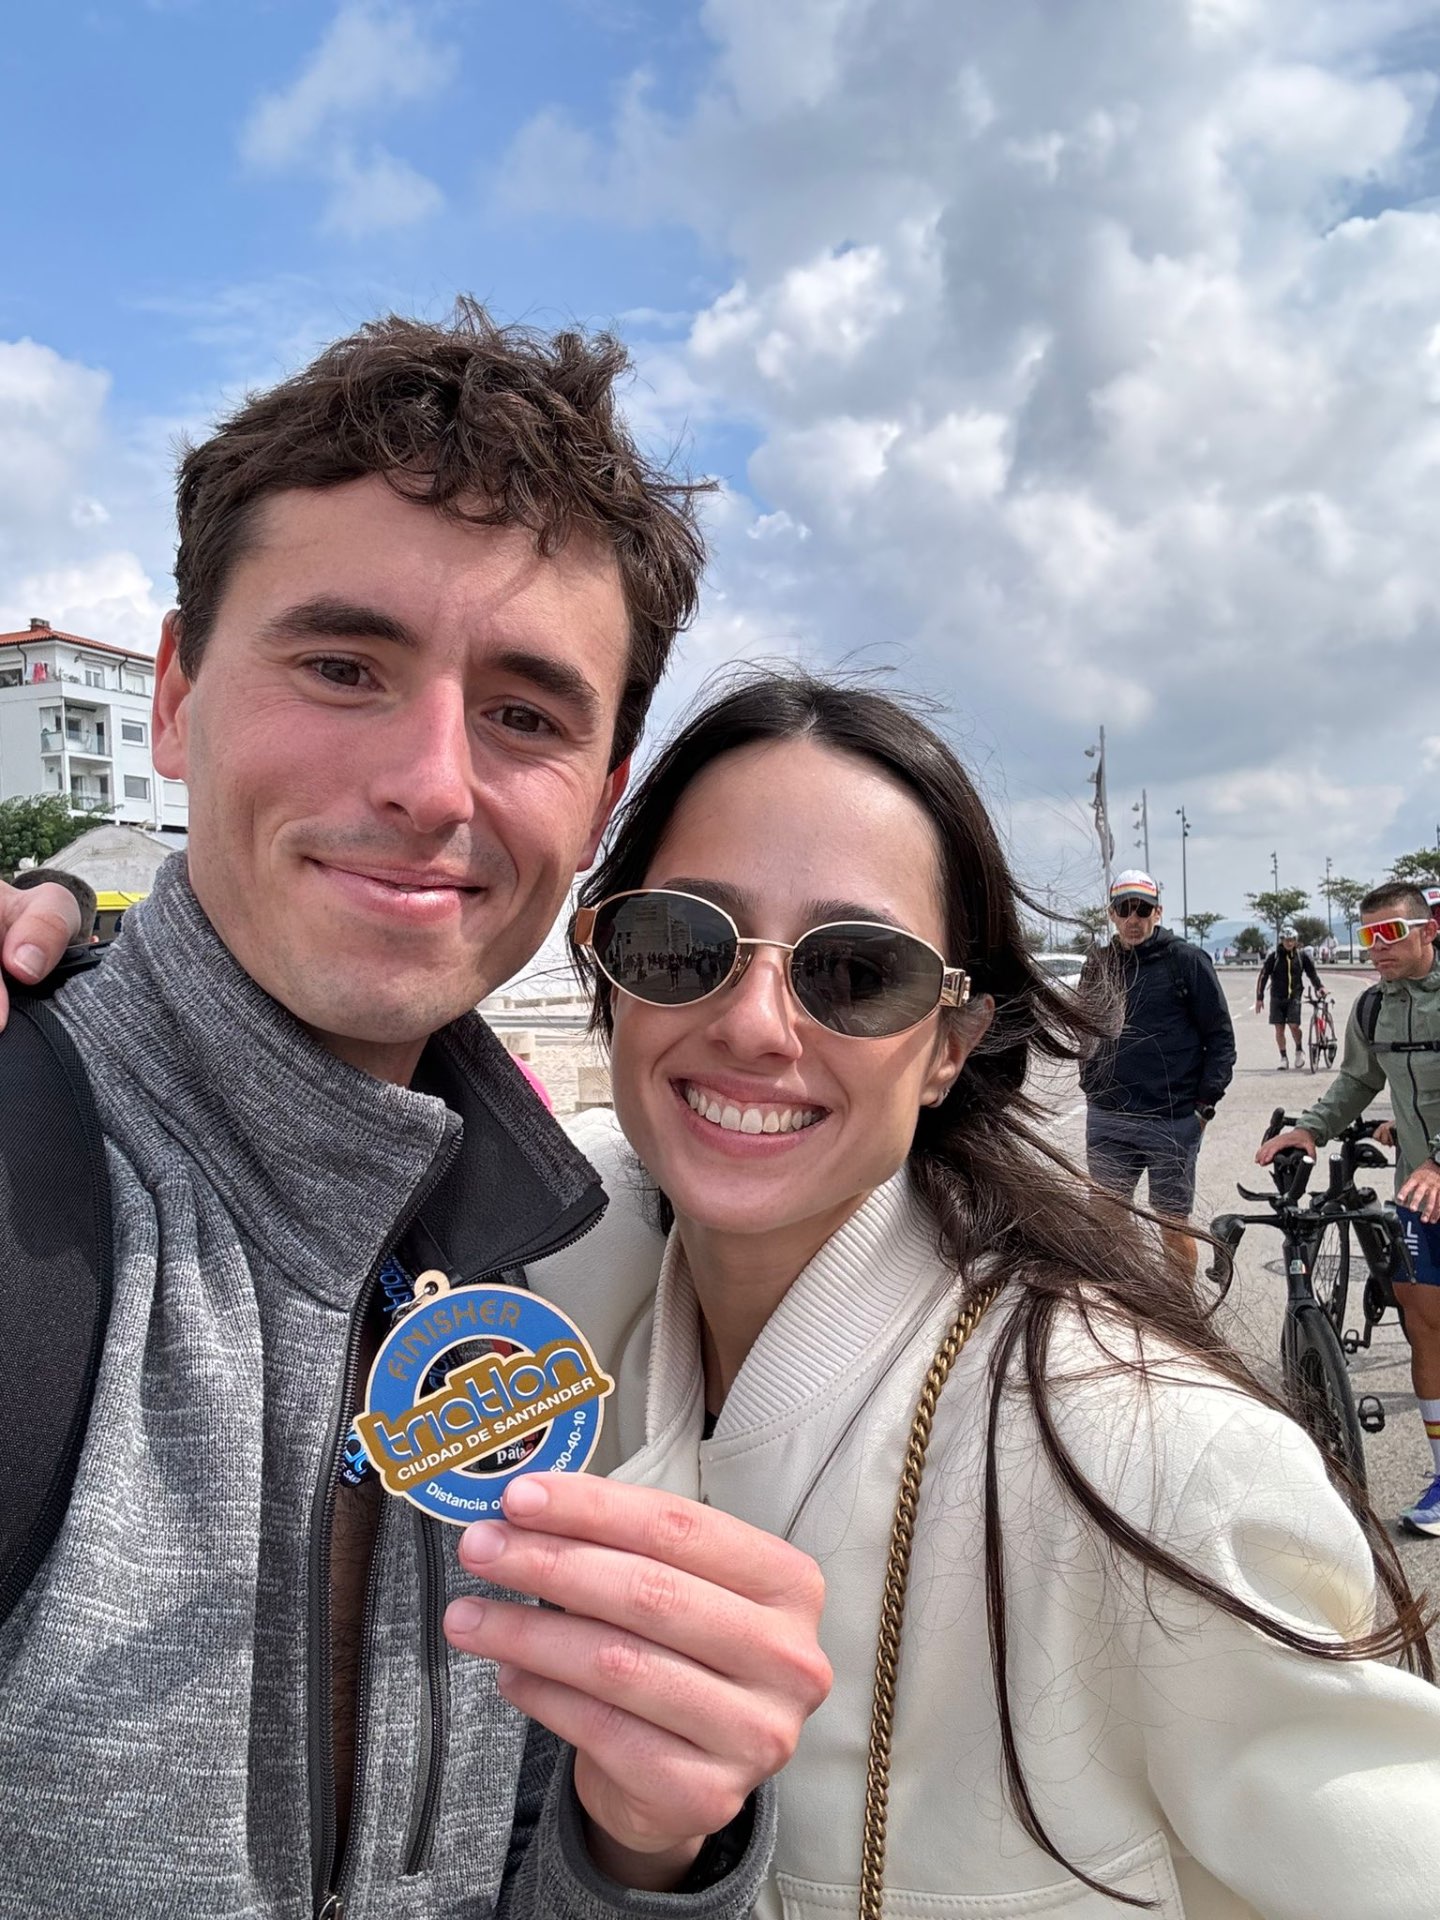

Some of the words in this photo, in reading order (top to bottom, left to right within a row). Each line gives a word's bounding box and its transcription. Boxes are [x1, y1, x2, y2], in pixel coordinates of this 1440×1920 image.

[388, 1299, 522, 1381] FINISHER
[373, 1347, 587, 1462] triatlon
[397, 1442, 463, 1480] CIUDAD
[466, 1428, 492, 1448] DE
[493, 1376, 596, 1435] SANTANDER
[425, 1482, 488, 1511] Distancia
